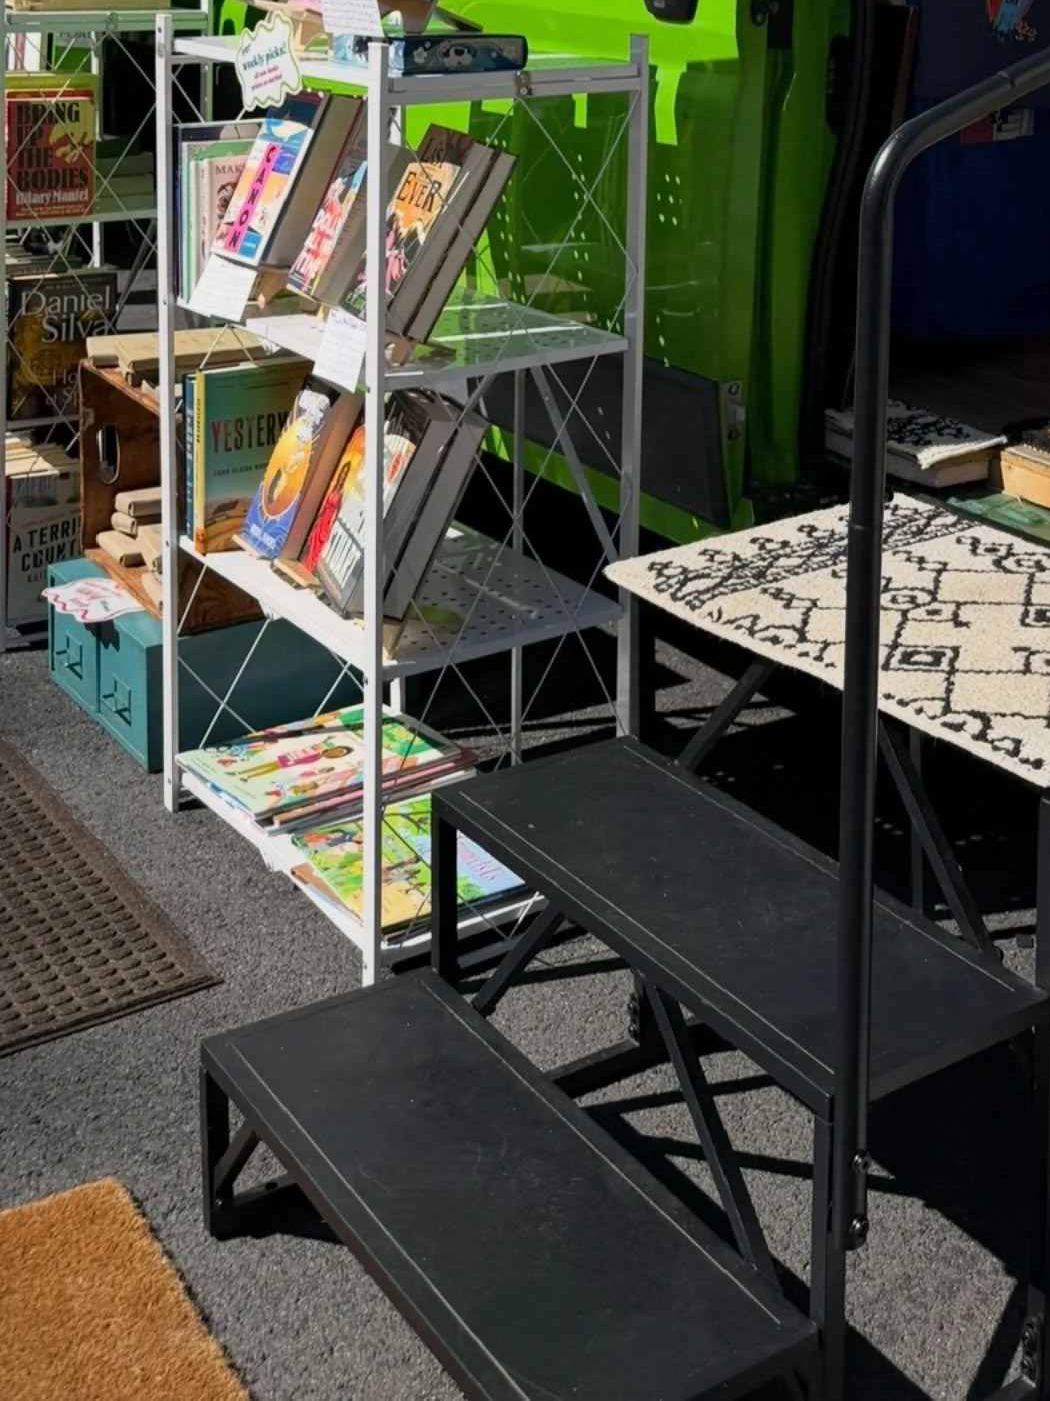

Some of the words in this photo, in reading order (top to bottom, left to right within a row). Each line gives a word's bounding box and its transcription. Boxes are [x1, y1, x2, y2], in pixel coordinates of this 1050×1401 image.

[242, 53, 265, 71] weekly
[265, 42, 287, 65] picks!
[16, 102, 80, 124] BRING
[16, 124, 44, 146] UP
[16, 147, 53, 168] THE
[15, 167, 88, 190] BODIES
[15, 191, 52, 206] Hilary
[53, 187, 88, 203] Mantel
[228, 146, 276, 248] CANON
[396, 170, 441, 213] EVER
[21, 285, 111, 316] Daniel
[41, 312, 110, 344] Silva
[13, 534, 22, 554] A
